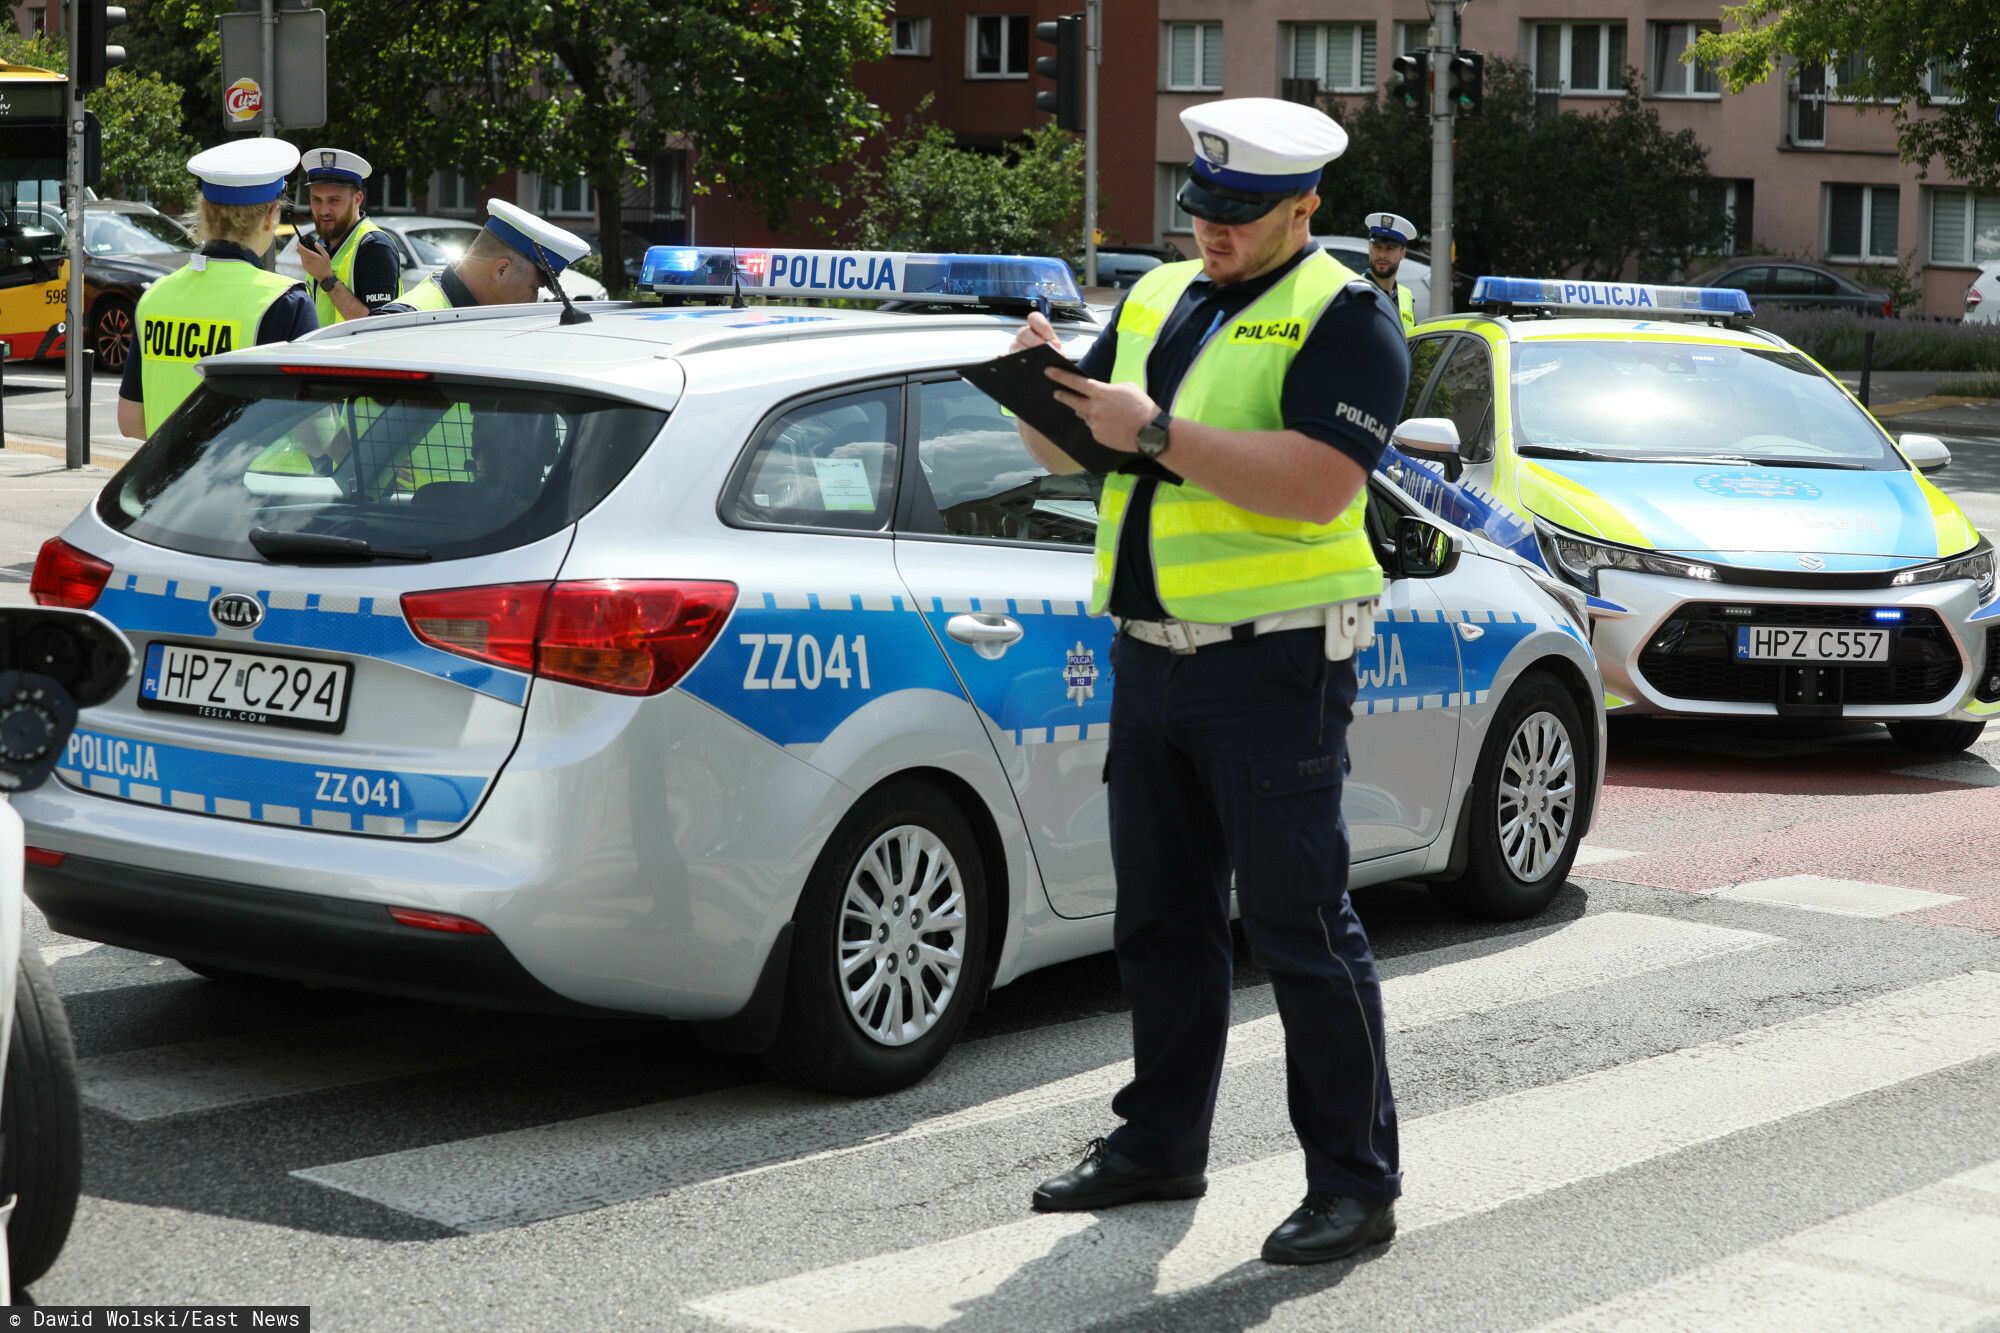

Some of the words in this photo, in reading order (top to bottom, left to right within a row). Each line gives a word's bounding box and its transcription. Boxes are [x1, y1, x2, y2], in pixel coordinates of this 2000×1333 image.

[769, 254, 896, 291] POLICJA
[366, 293, 392, 303] POLICJA
[1564, 284, 1653, 307] POLICJA
[144, 320, 232, 358] POLICJA
[1234, 322, 1300, 341] POLICJA
[1335, 401, 1388, 444] POLICJA
[217, 600, 252, 622] KIA
[1738, 646, 1748, 654] PL
[1755, 629, 1808, 658] HPZ
[1818, 631, 1883, 659] C557
[739, 633, 871, 690] ZZ041
[1070, 656, 1091, 664] POLICJA
[145, 677, 158, 692] PL
[165, 652, 232, 703] HPZ
[243, 661, 338, 717] C294
[199, 706, 267, 723] TESLA.COM
[67, 732, 159, 781] POLICJA
[315, 771, 400, 809] ZZ041
